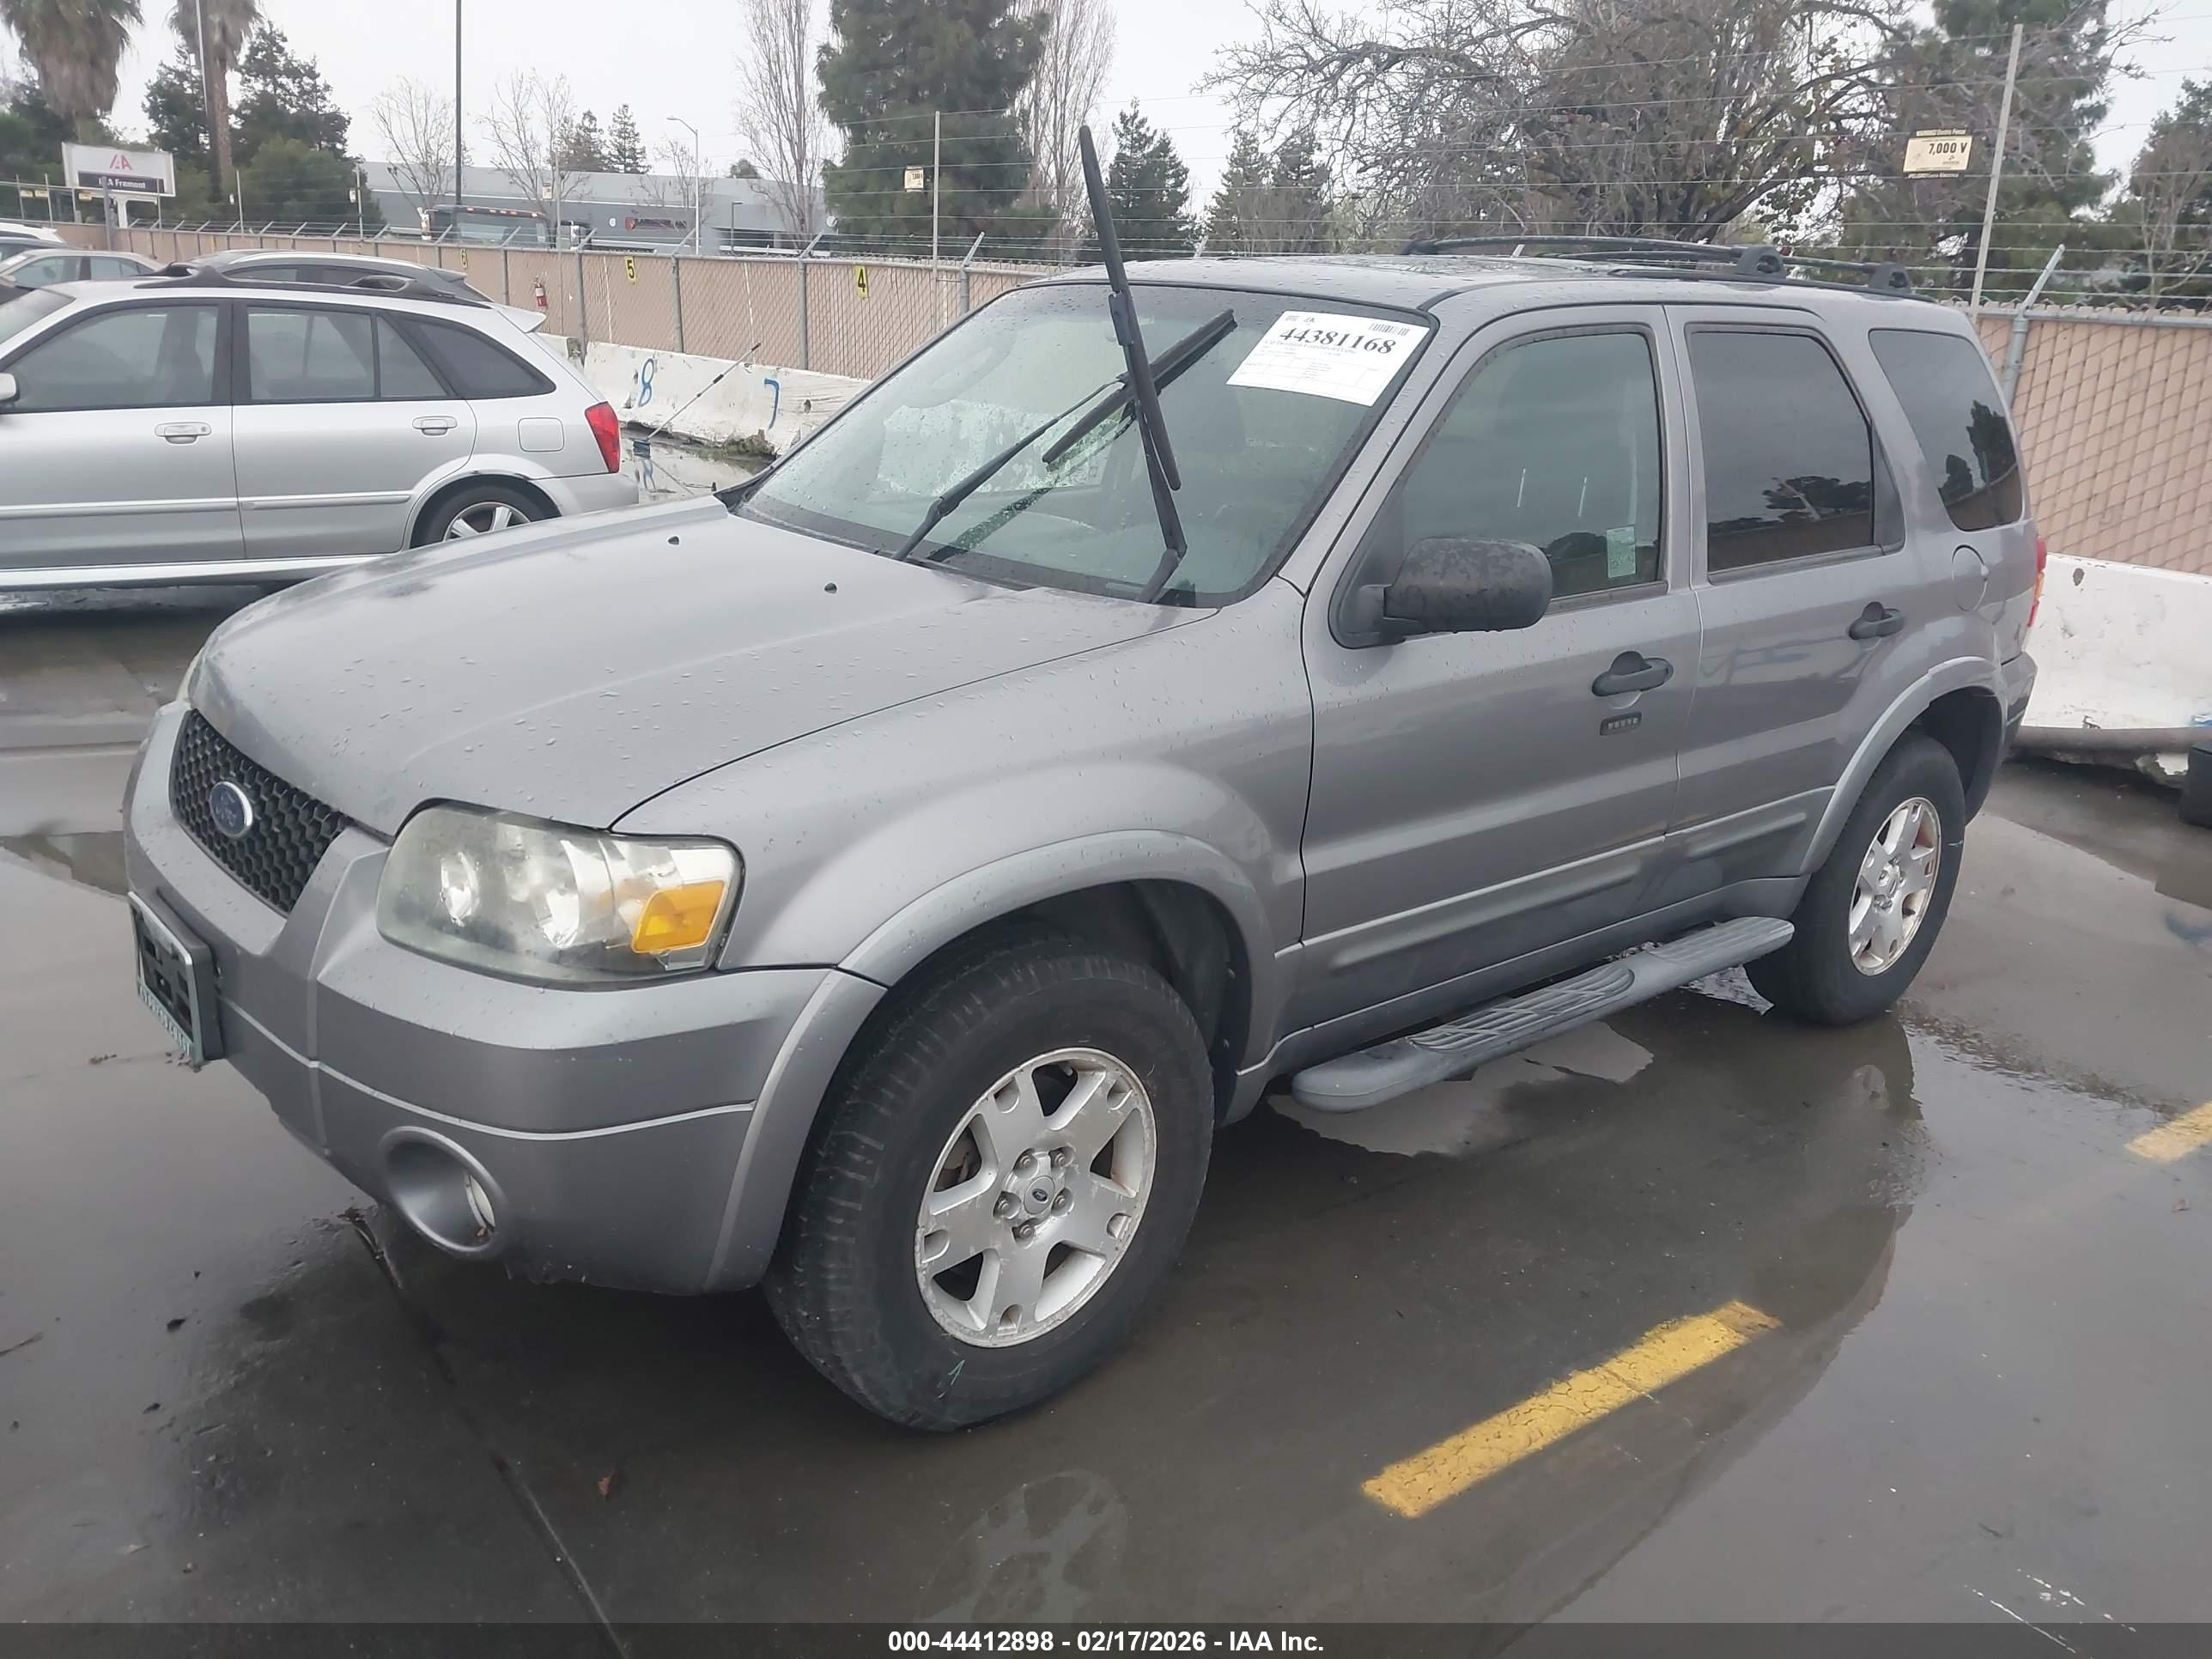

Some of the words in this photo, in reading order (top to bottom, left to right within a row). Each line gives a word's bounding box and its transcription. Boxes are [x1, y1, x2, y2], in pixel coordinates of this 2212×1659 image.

[1929, 143, 1957, 155] 7,000
[1960, 143, 1968, 153] V
[626, 259, 635, 278] 5
[858, 268, 866, 293] 4
[1279, 327, 1397, 354] 44381168
[638, 358, 654, 406] 8
[763, 378, 780, 429] 7
